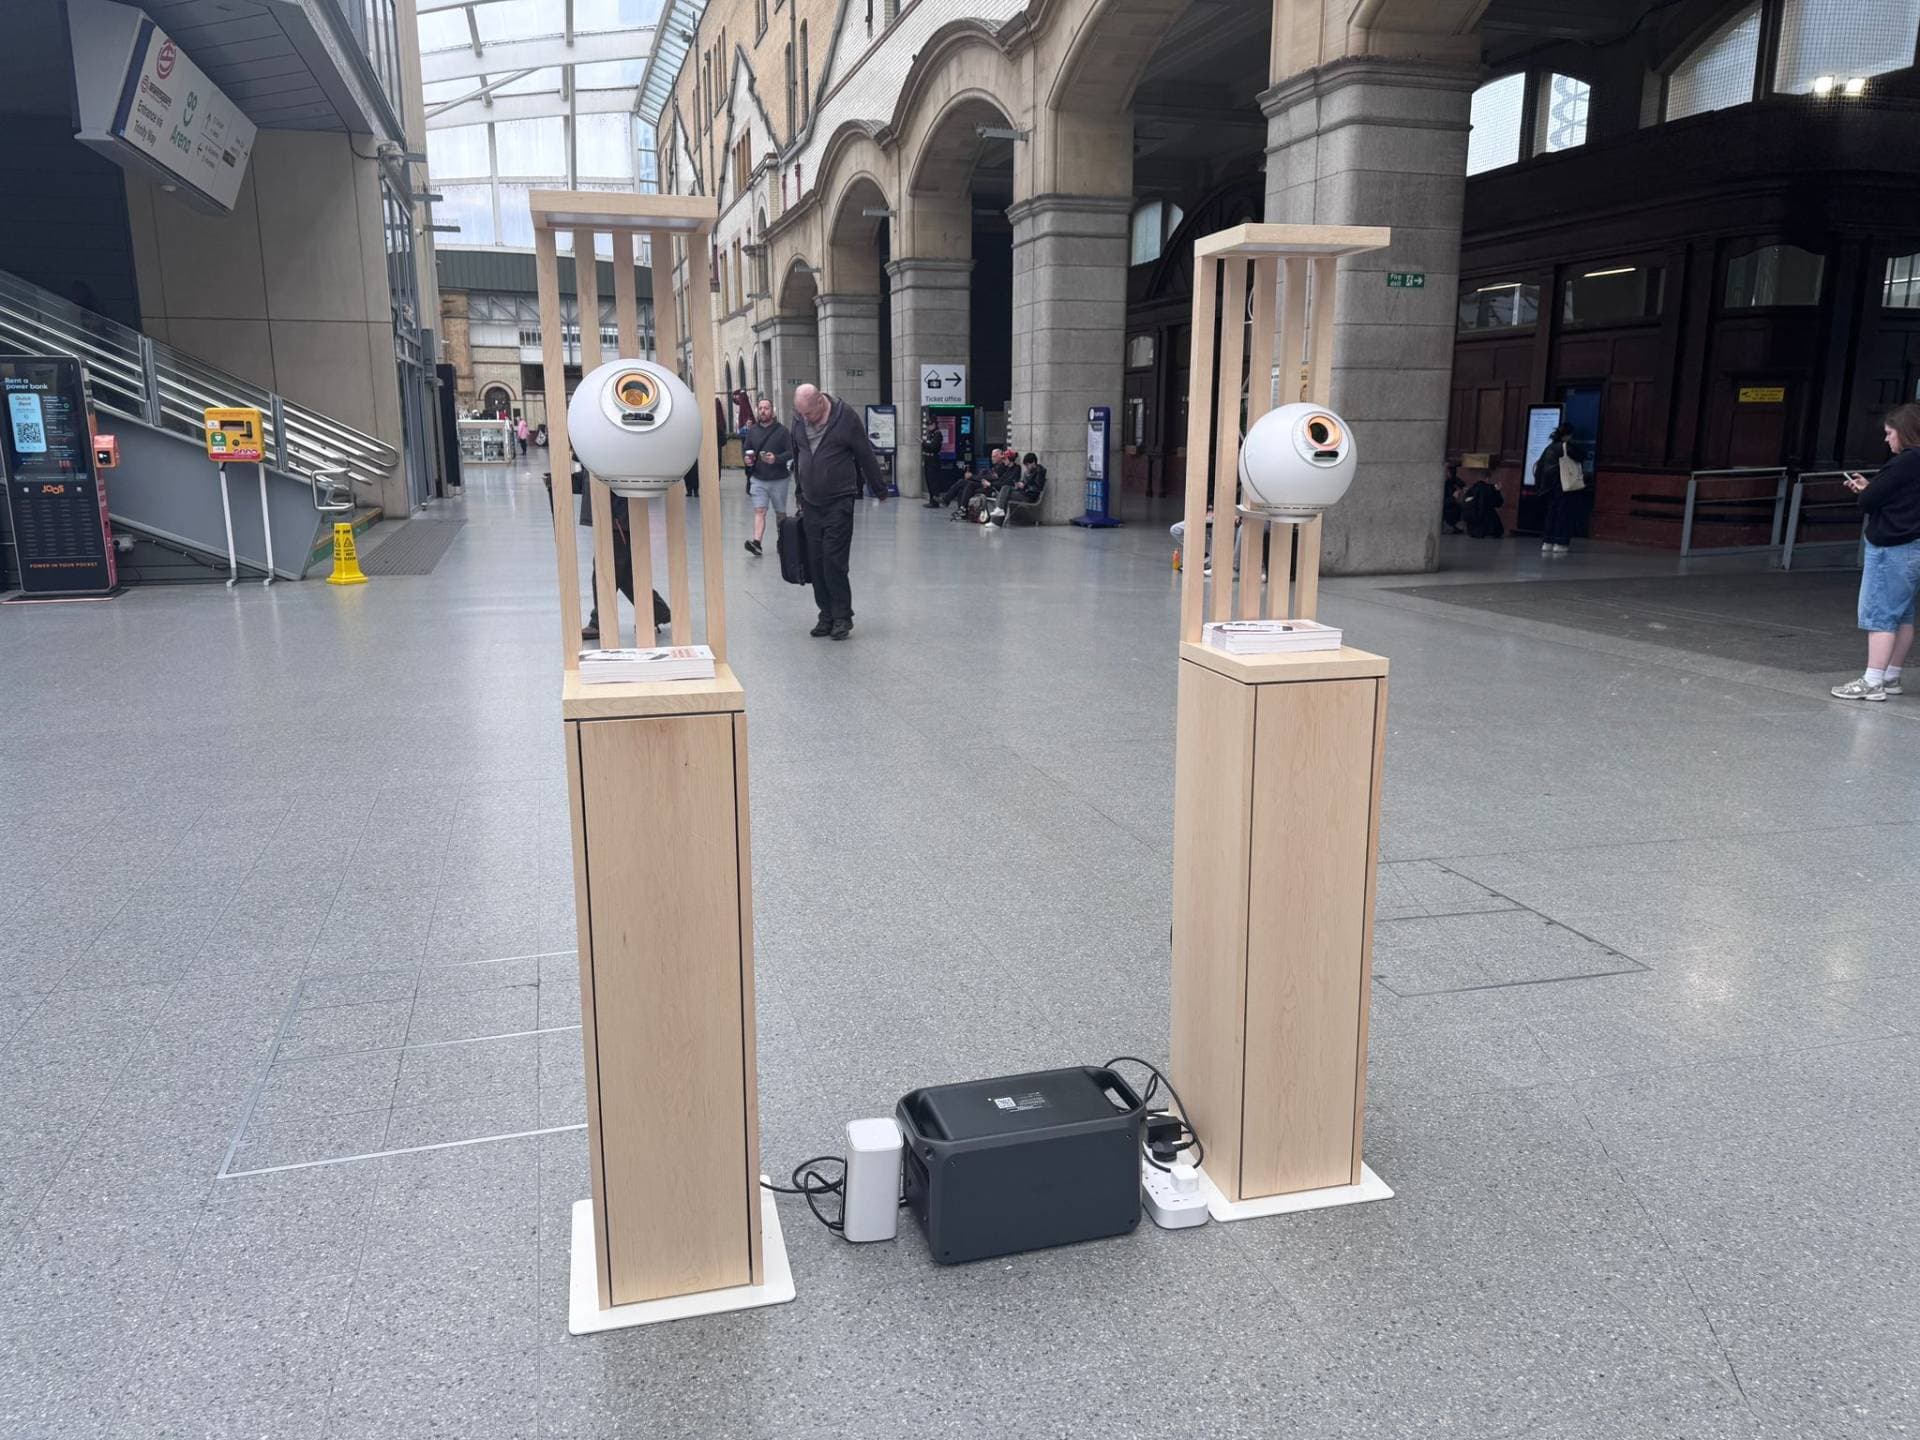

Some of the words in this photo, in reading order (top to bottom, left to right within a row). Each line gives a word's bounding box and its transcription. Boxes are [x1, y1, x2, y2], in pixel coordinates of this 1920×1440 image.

[137, 99, 157, 123] Entrance
[156, 115, 164, 128] via
[134, 120, 147, 141] Trinity
[147, 129, 157, 147] Way
[170, 125, 191, 153] Arena
